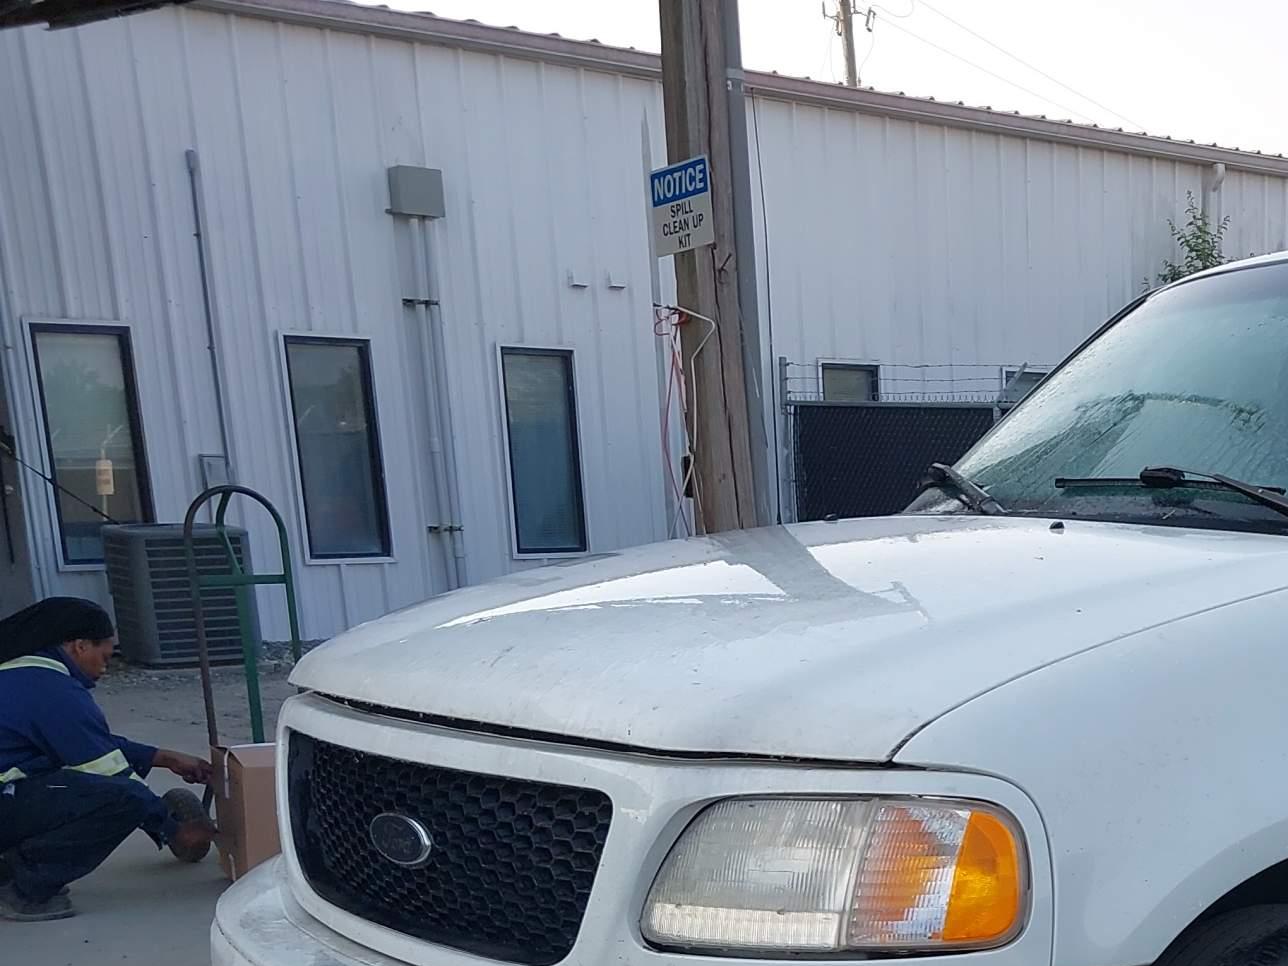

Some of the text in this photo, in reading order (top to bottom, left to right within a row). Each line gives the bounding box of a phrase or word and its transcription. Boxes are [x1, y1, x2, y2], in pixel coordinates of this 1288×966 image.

[653, 164, 705, 201] NOTICE
[670, 200, 694, 218] SPILL
[662, 213, 704, 237] CLEAN UP
[678, 233, 691, 248] KIT
